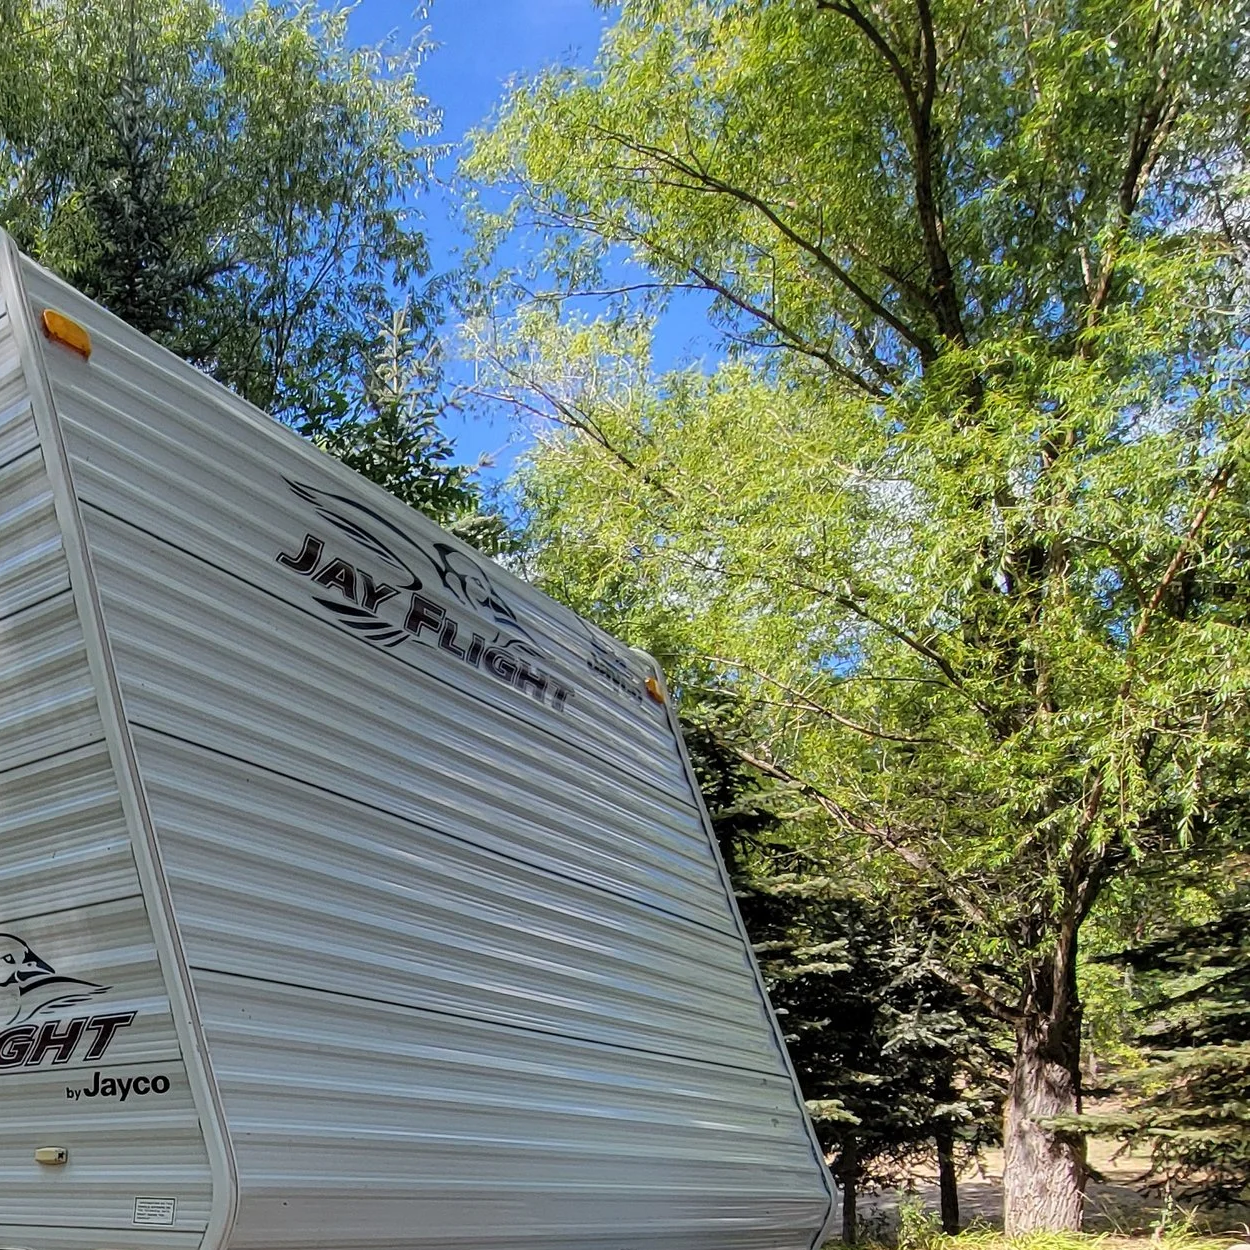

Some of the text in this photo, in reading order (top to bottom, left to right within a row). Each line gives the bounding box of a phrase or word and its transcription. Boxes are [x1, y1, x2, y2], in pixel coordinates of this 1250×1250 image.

[276, 533, 401, 613] JAY
[403, 592, 575, 713] FLIGHT
[66, 1072, 170, 1102] by Jayco
